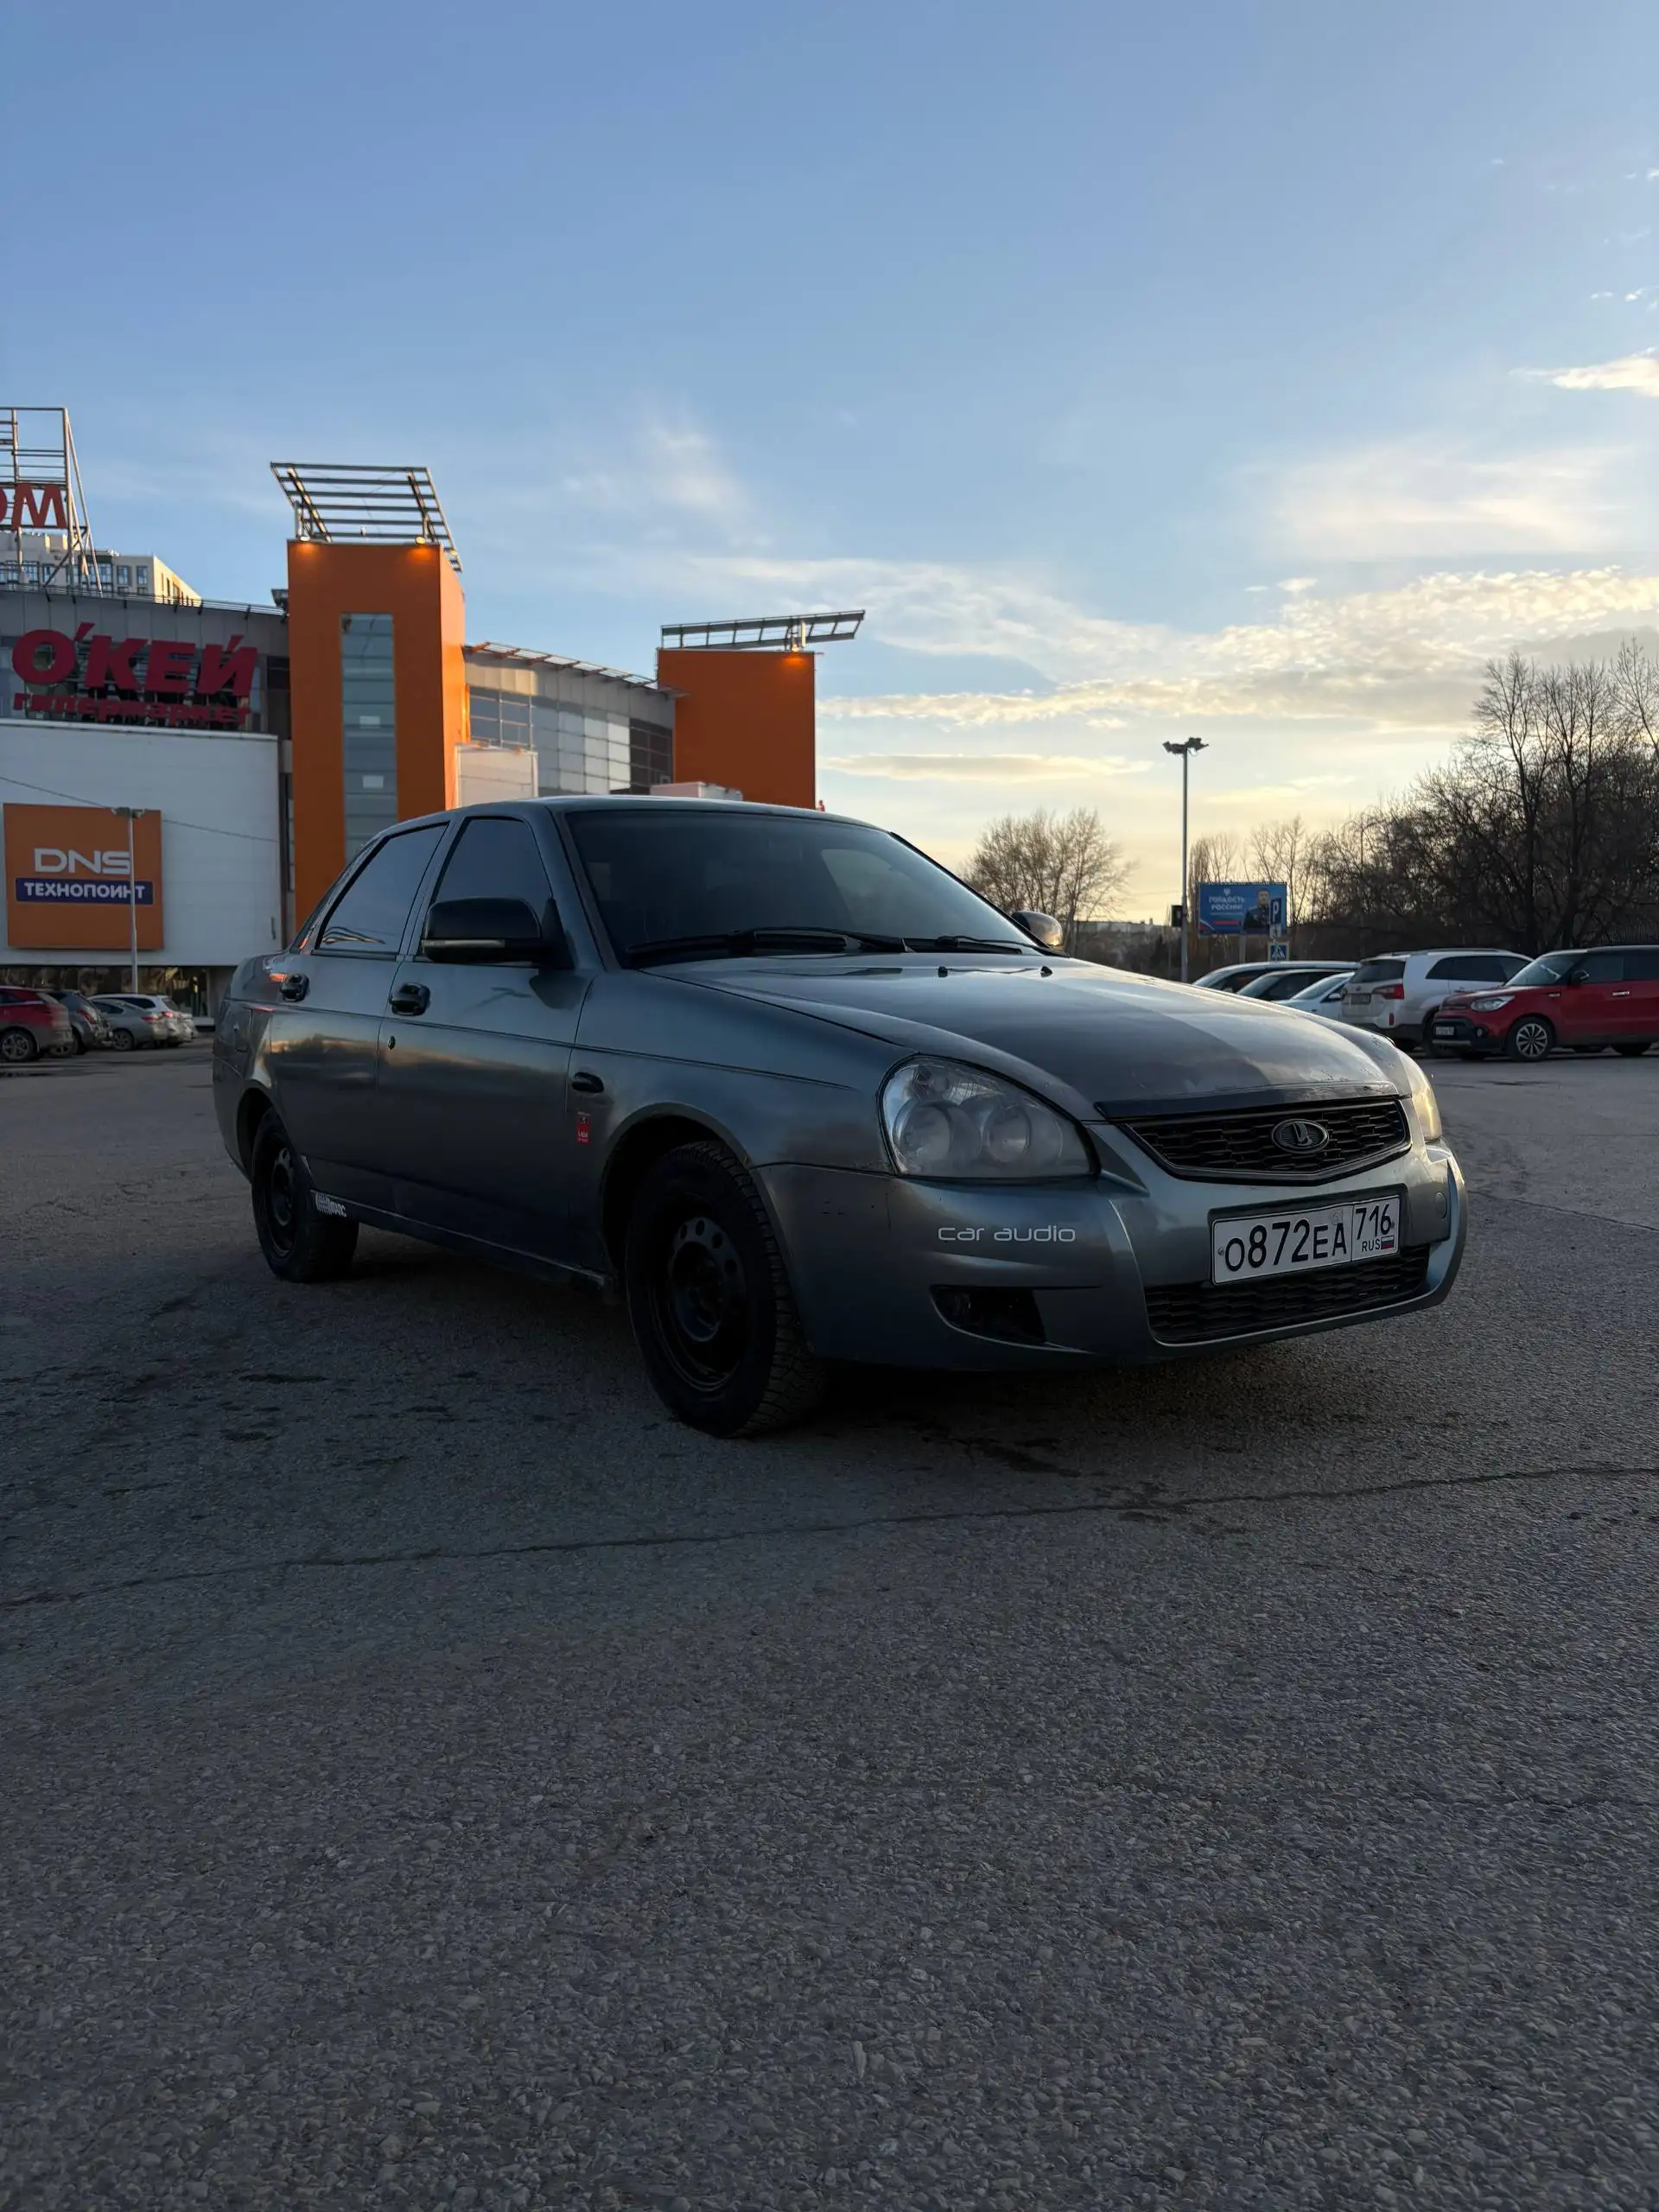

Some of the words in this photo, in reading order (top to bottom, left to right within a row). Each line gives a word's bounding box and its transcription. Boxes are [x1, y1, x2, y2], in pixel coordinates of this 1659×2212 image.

[0, 483, 67, 530] М
[34, 848, 131, 874] DNS
[938, 1227, 985, 1241] car
[994, 1224, 1076, 1242] audio
[1355, 1203, 1392, 1240] 716
[1361, 1239, 1381, 1252] RUS
